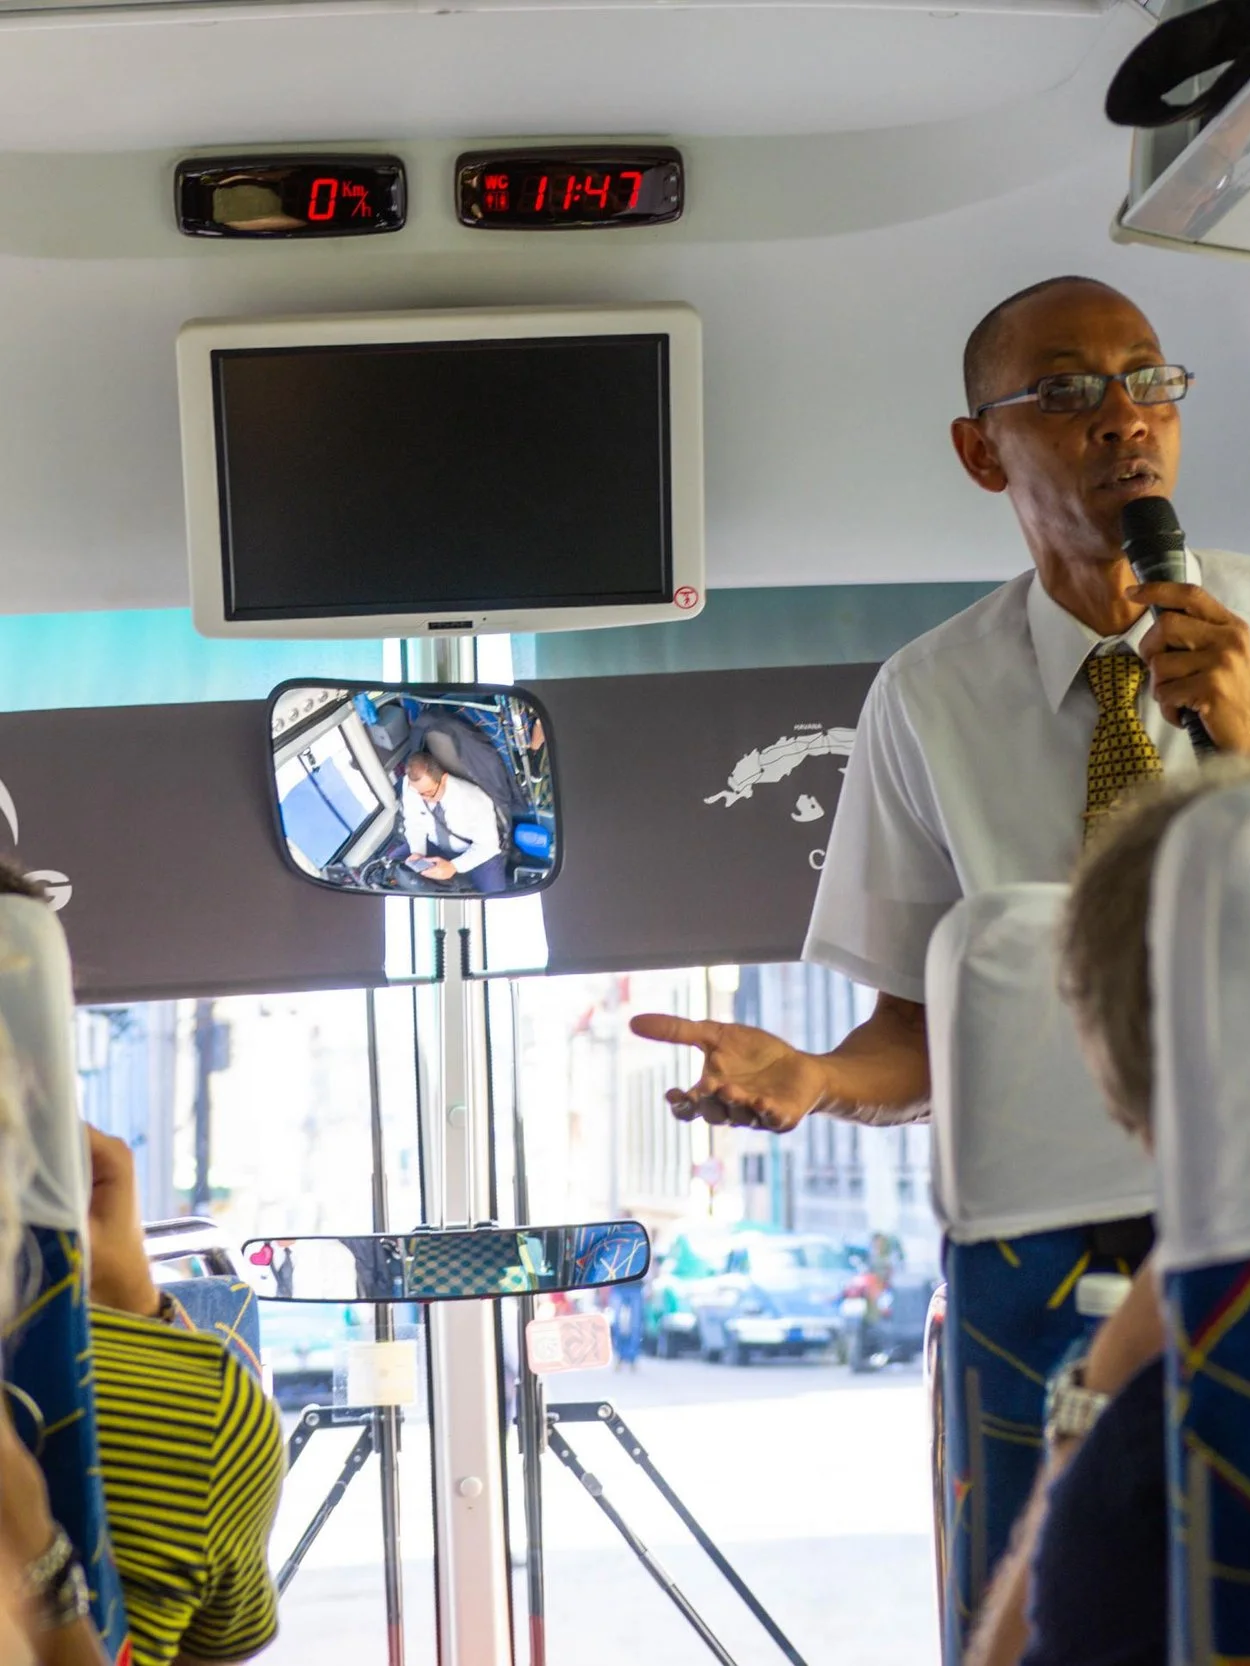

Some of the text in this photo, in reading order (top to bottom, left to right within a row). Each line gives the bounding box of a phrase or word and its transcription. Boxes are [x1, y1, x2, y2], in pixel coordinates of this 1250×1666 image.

[308, 178, 338, 220] 0
[484, 174, 509, 190] WC
[534, 171, 643, 211] 11:47
